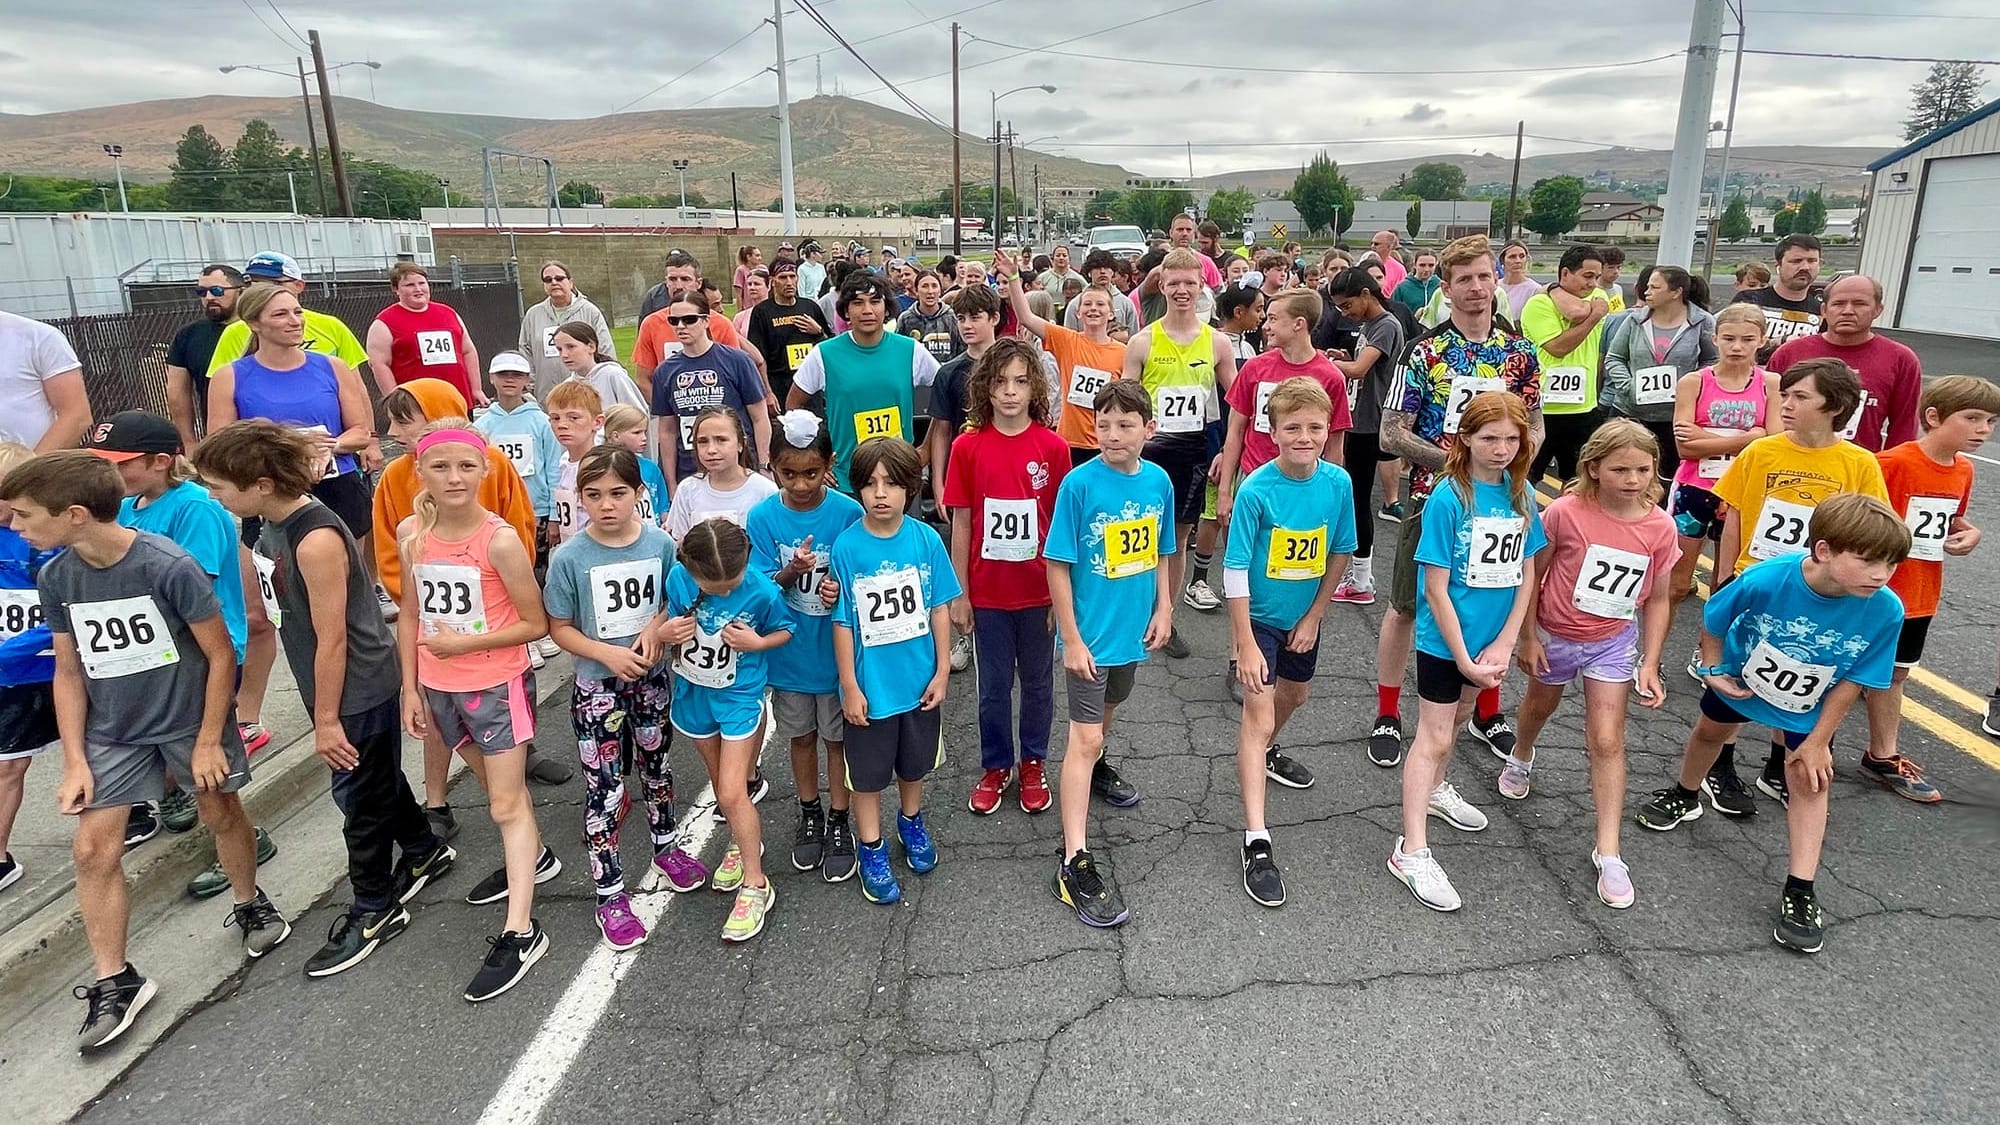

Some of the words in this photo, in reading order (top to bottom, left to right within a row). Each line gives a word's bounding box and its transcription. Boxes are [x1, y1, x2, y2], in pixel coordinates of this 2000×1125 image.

[1764, 316, 1820, 338] TEELERS
[425, 338, 450, 353] 246
[688, 386, 710, 396] WITH
[711, 386, 725, 395] ME
[1075, 374, 1105, 395] 265
[1550, 375, 1581, 391] 209
[1641, 373, 1671, 392] 210
[685, 396, 708, 404] GOOSE
[1164, 395, 1197, 417] 274
[865, 414, 890, 434] 317
[990, 512, 1030, 540] 291
[1765, 513, 1810, 548] 23
[1120, 526, 1149, 555] 323
[1284, 537, 1318, 561] 320
[1481, 532, 1522, 564] 260
[1588, 560, 1644, 598] 277
[423, 580, 472, 615] 233
[604, 574, 655, 613] 384
[866, 585, 916, 622] 258
[0, 604, 43, 633] 88
[84, 613, 155, 653] 296
[684, 635, 731, 669] 239
[1755, 656, 1820, 697] 203
[1371, 724, 1401, 741] adida
